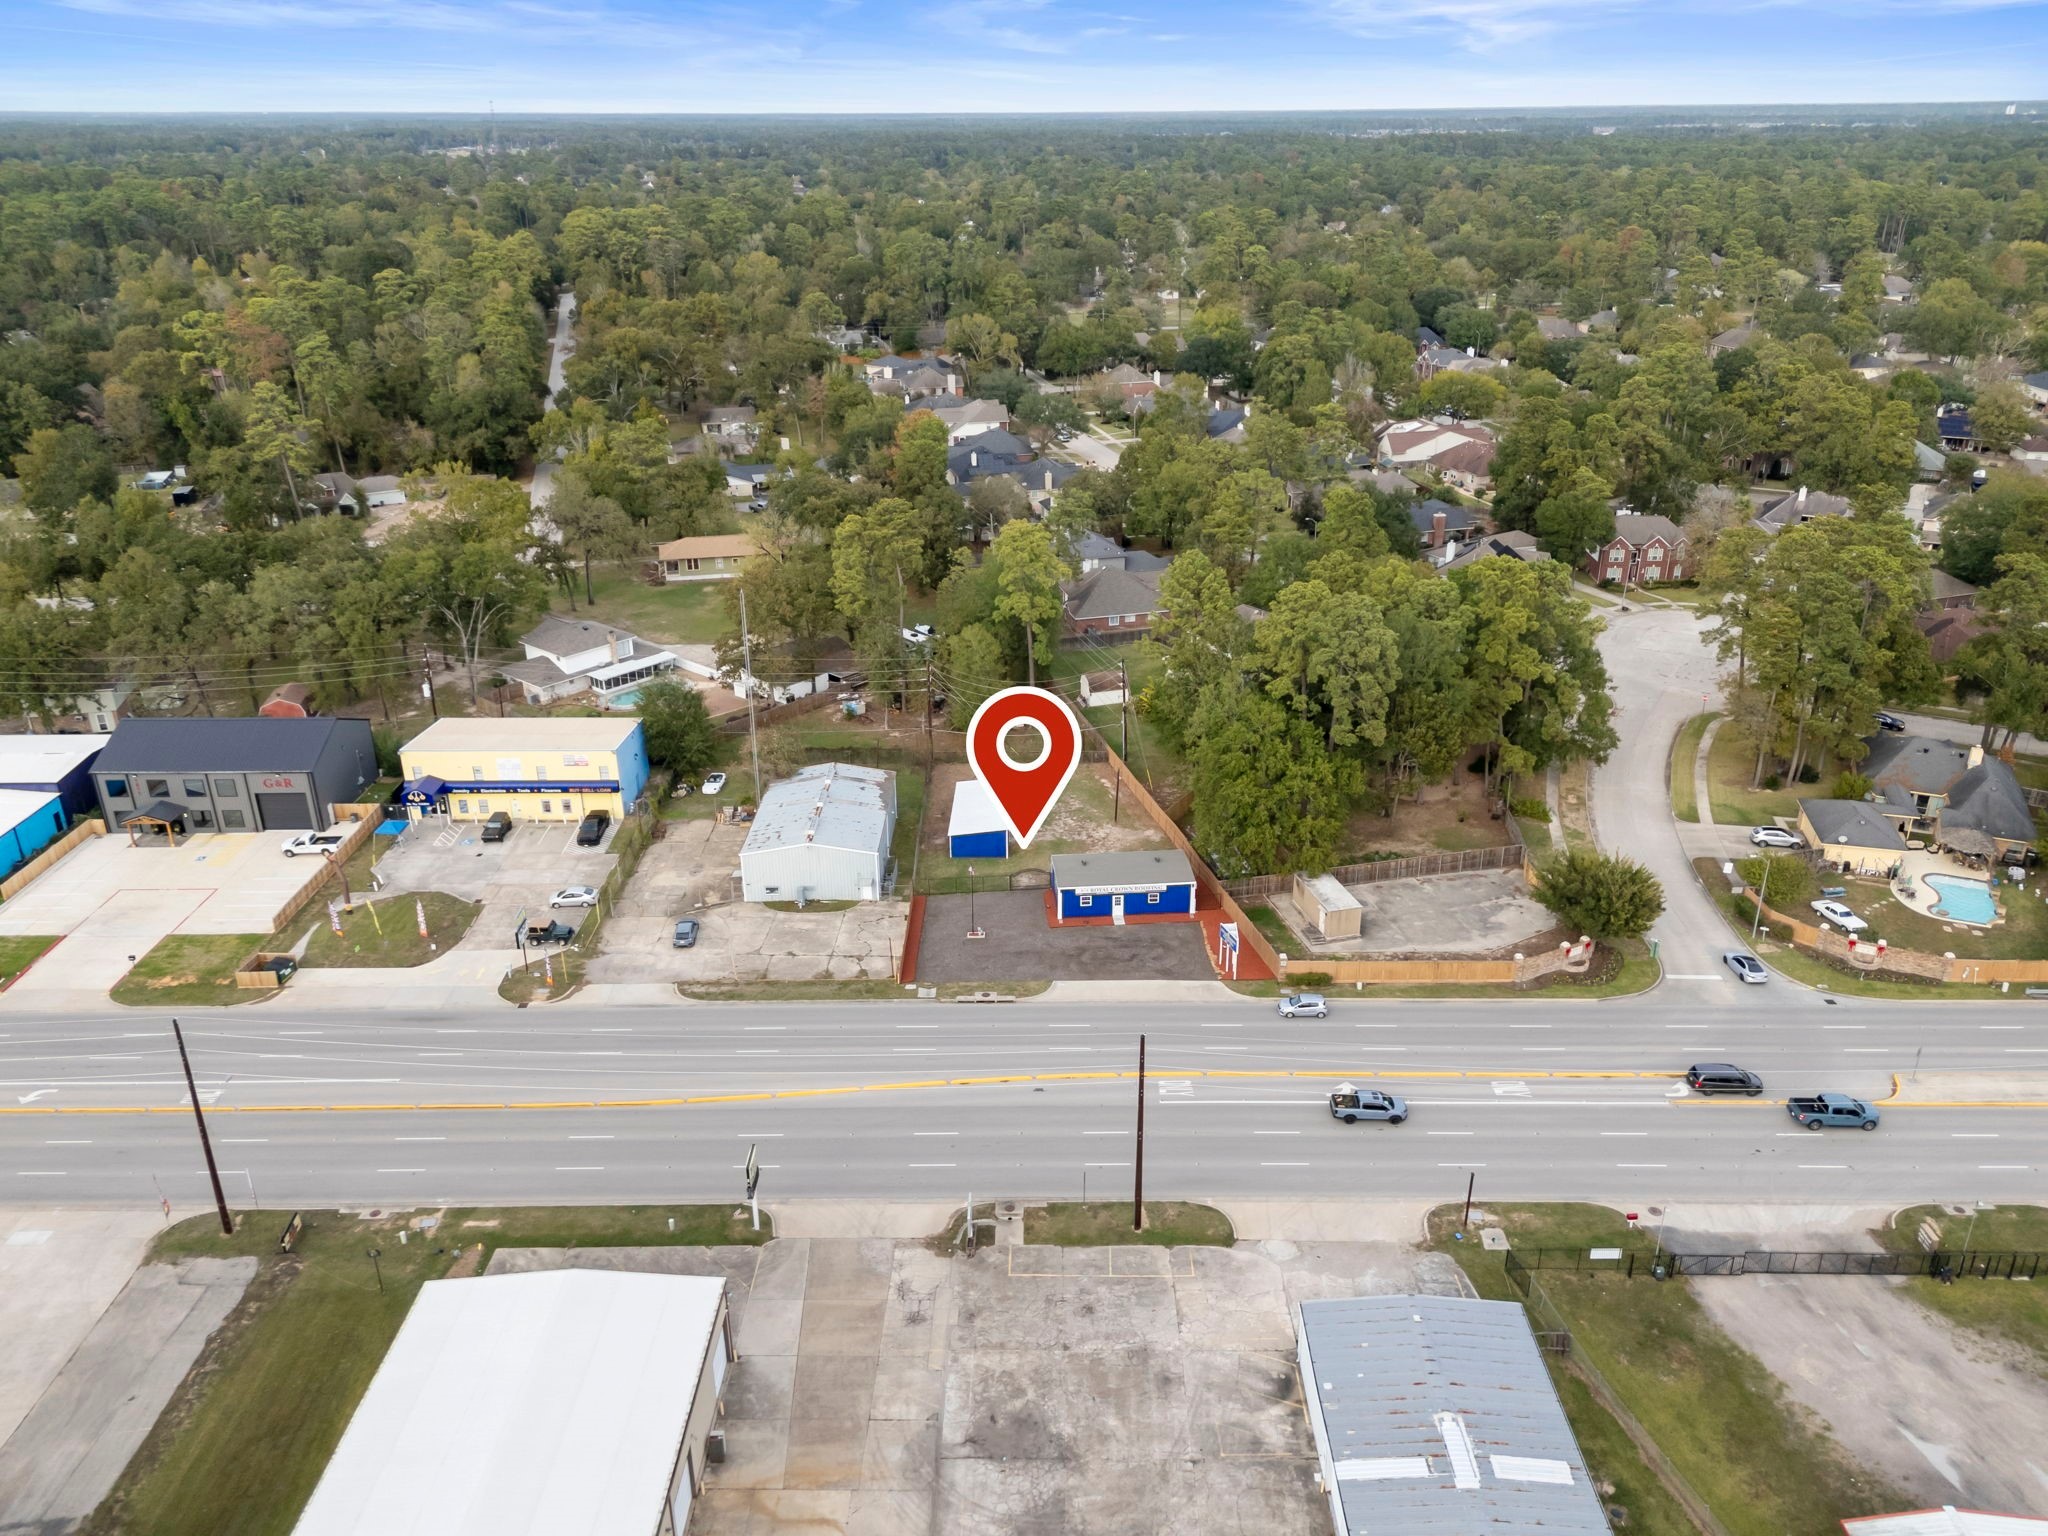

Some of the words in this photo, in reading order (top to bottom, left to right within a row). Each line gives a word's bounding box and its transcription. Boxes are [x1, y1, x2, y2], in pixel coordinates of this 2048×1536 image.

[264, 778, 294, 788] G&R
[1159, 1080, 1195, 1096] ONLY
[1490, 1081, 1533, 1097] ONLY
